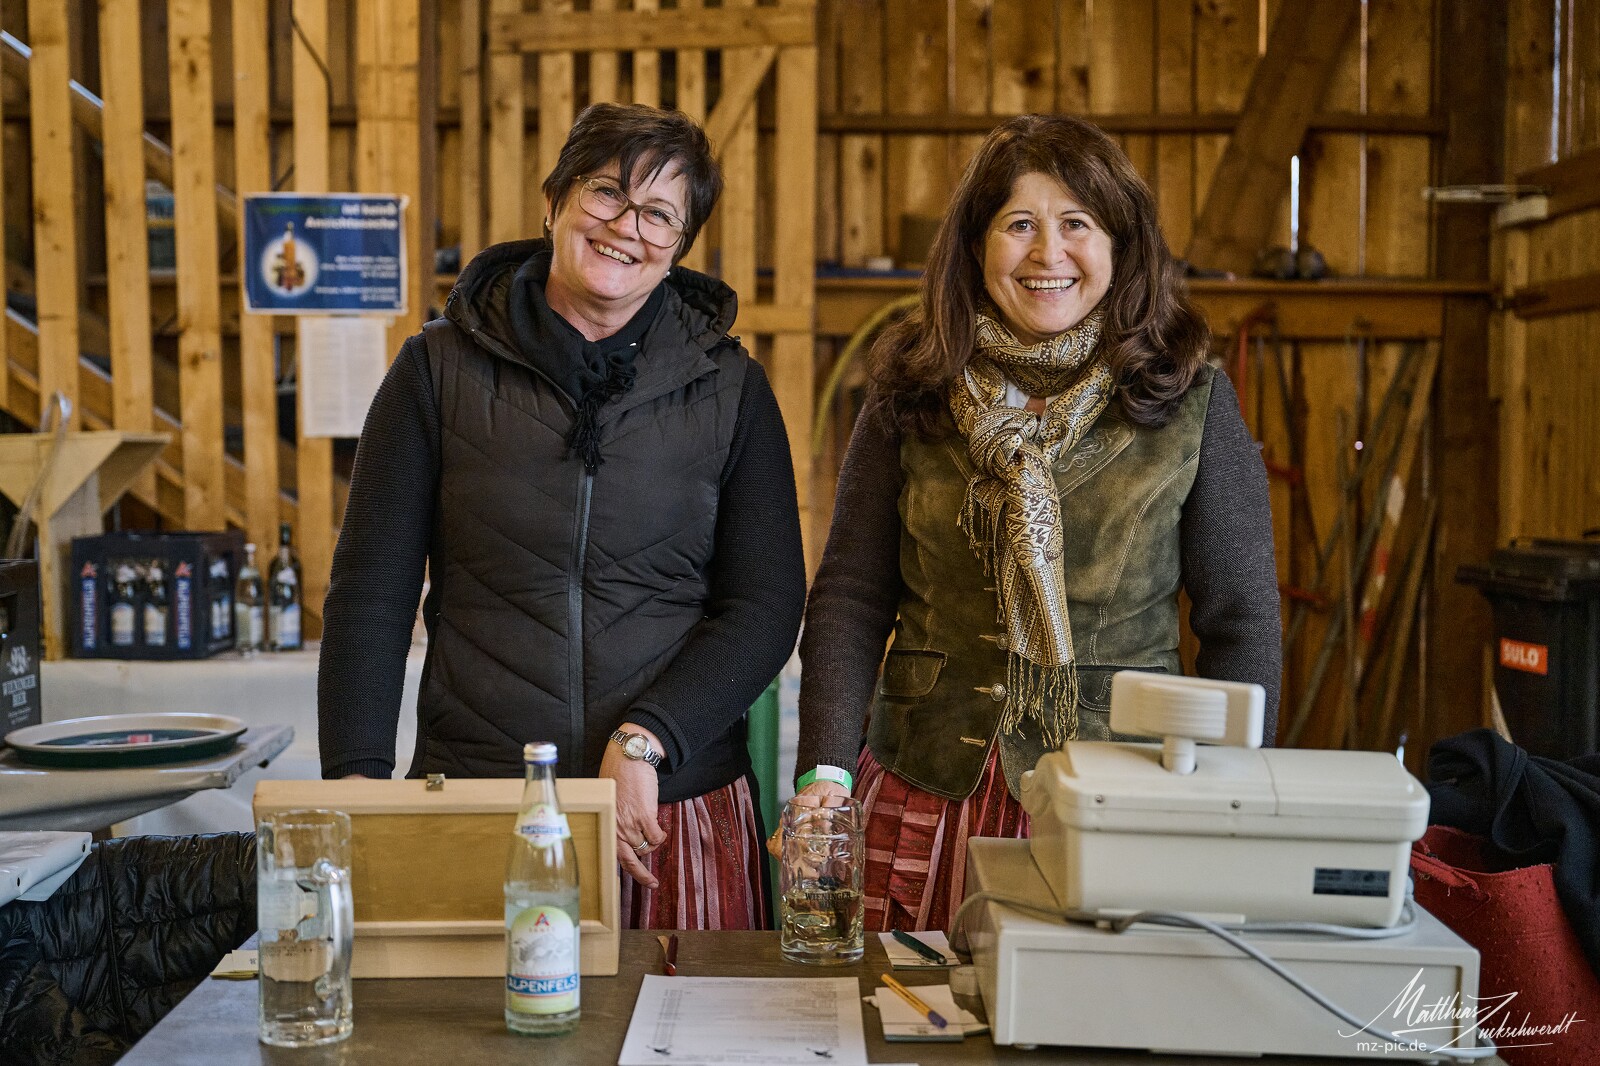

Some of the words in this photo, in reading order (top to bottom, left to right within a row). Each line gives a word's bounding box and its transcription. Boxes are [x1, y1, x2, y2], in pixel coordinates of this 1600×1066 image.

[1503, 642, 1539, 667] SULO
[805, 891, 852, 901] WIENINGER
[507, 974, 577, 992] ALPENFELS
